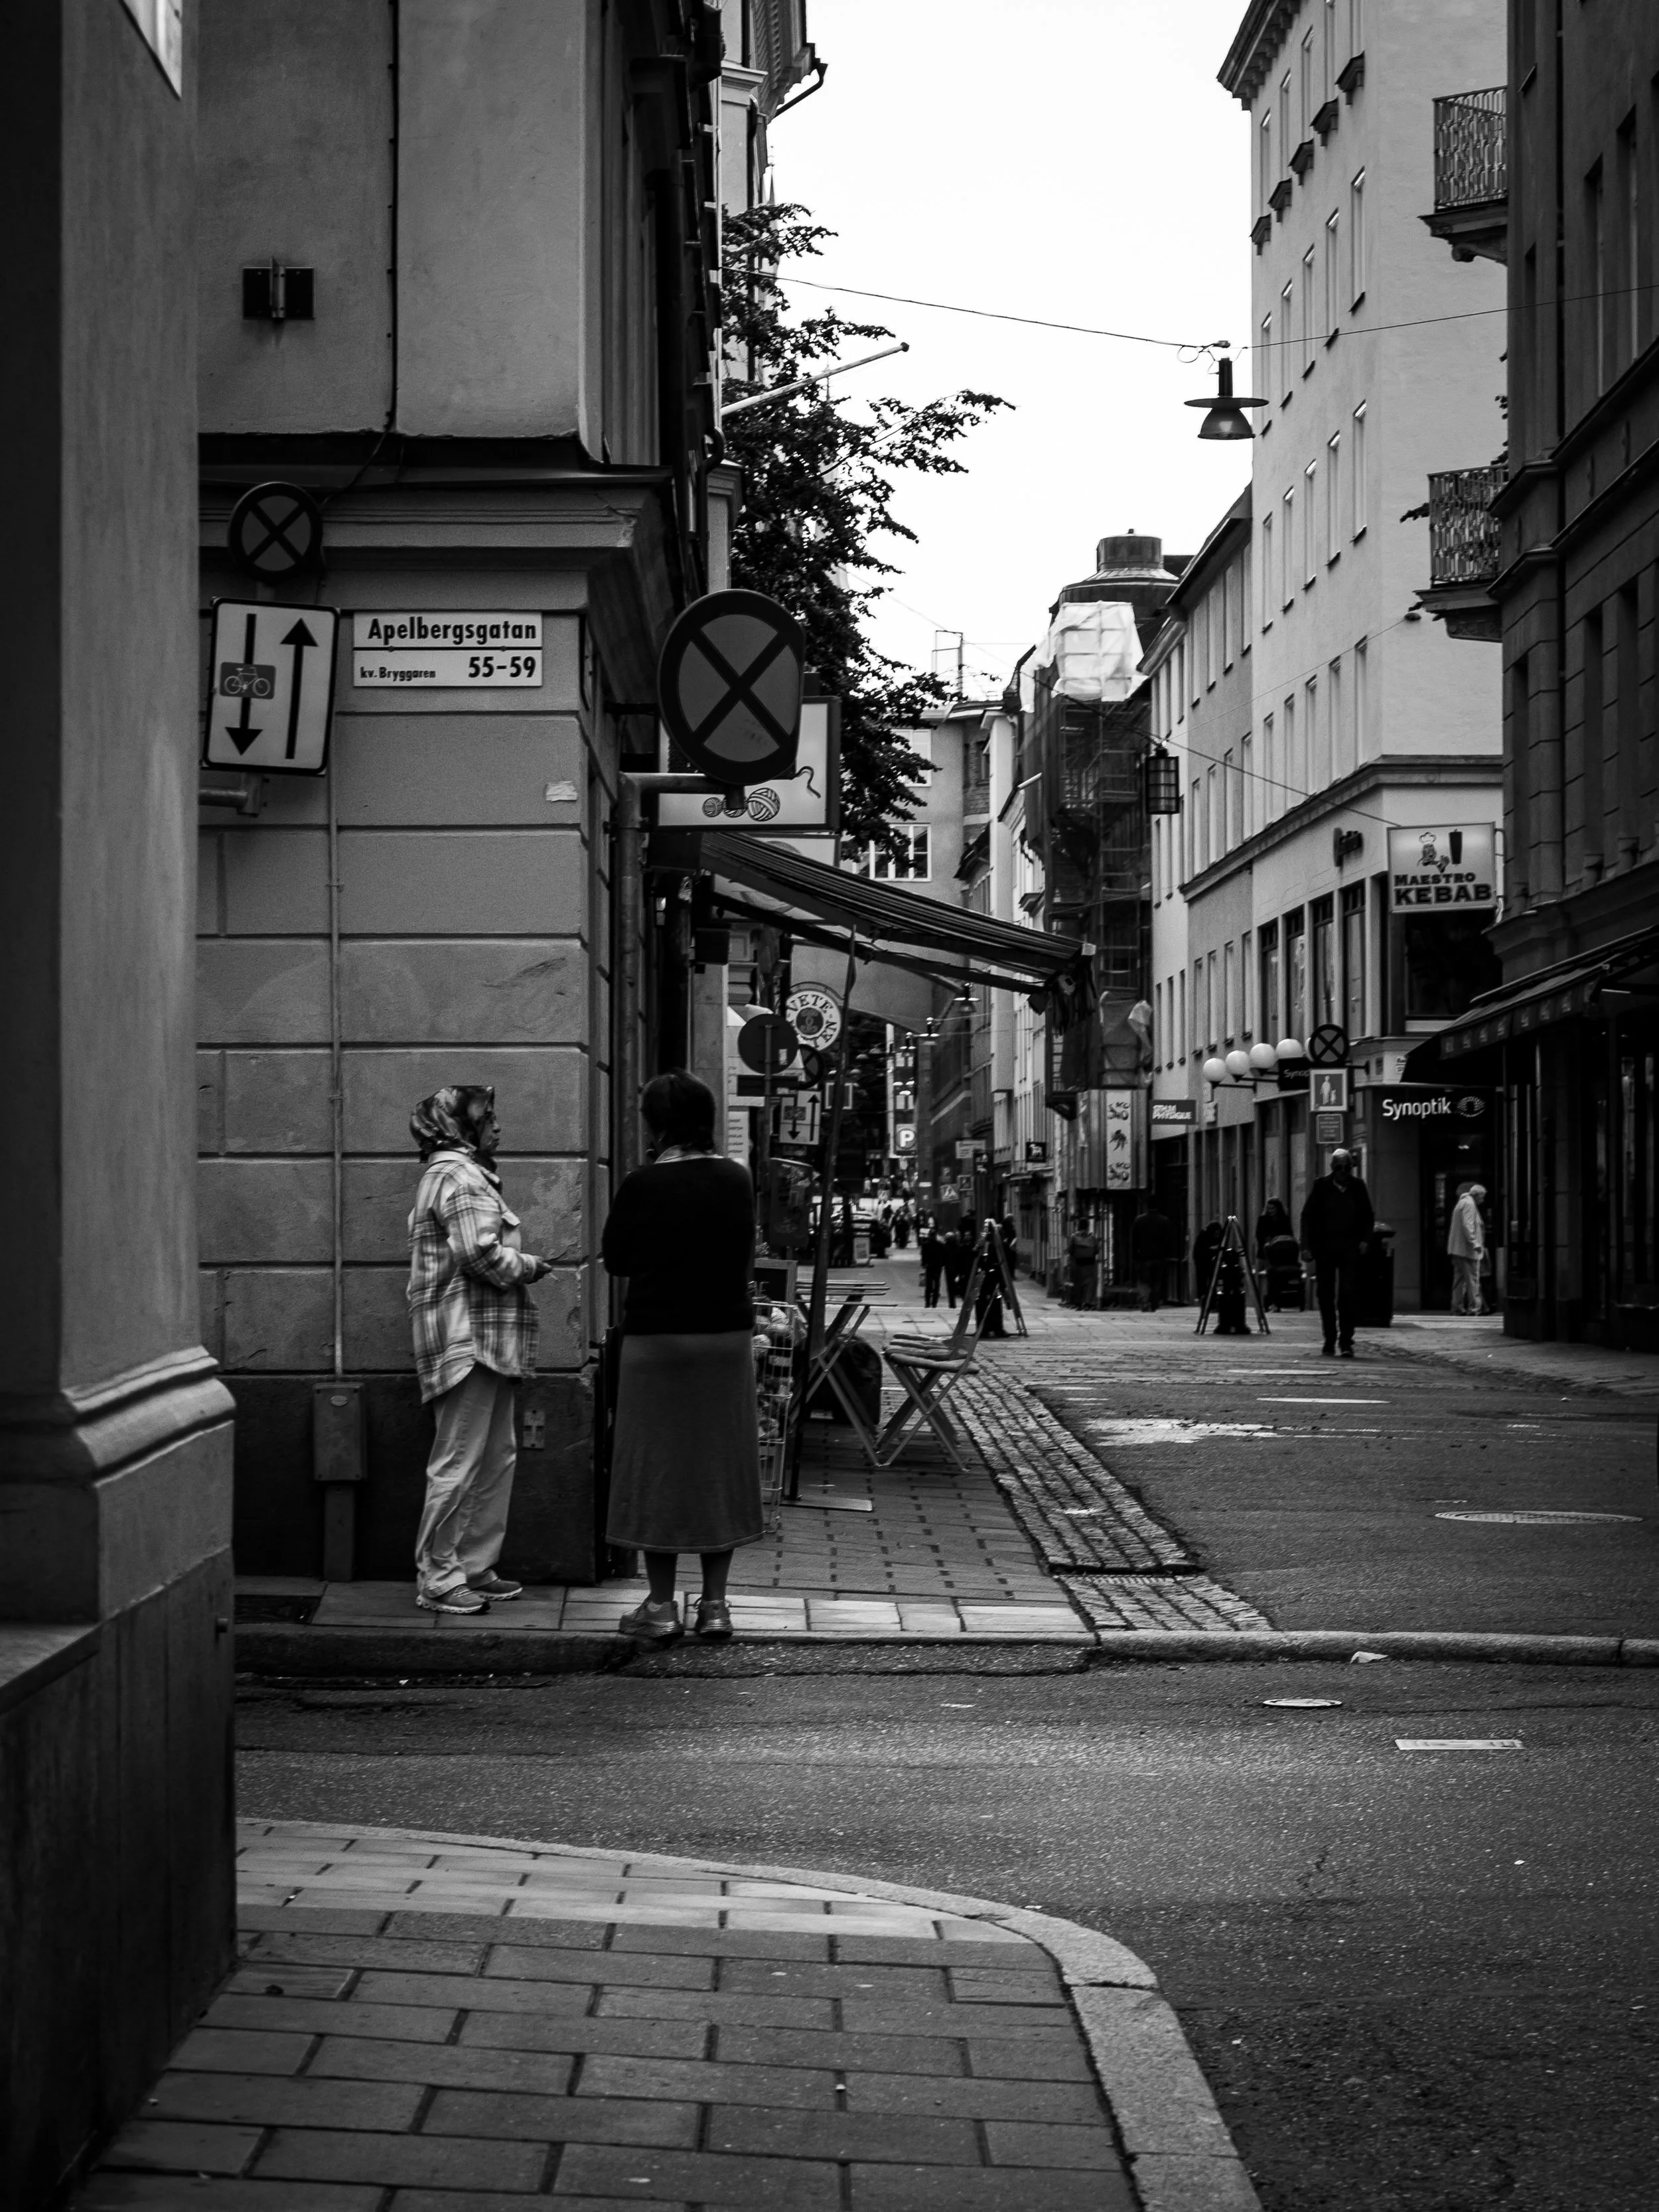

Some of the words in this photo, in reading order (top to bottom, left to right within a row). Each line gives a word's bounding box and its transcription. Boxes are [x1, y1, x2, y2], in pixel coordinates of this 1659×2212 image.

[368, 616, 537, 645] Apelbergsgatan
[360, 666, 378, 679] kv.
[379, 666, 436, 682] Bryggaren
[468, 656, 536, 678] 55-59
[1394, 872, 1475, 887] MAESTRO
[1394, 883, 1492, 905] KEBAB
[786, 994, 834, 1013] VETE
[1283, 1069, 1311, 1080] Synop
[1382, 1096, 1453, 1121] Synoptik
[900, 1130, 914, 1147] P
